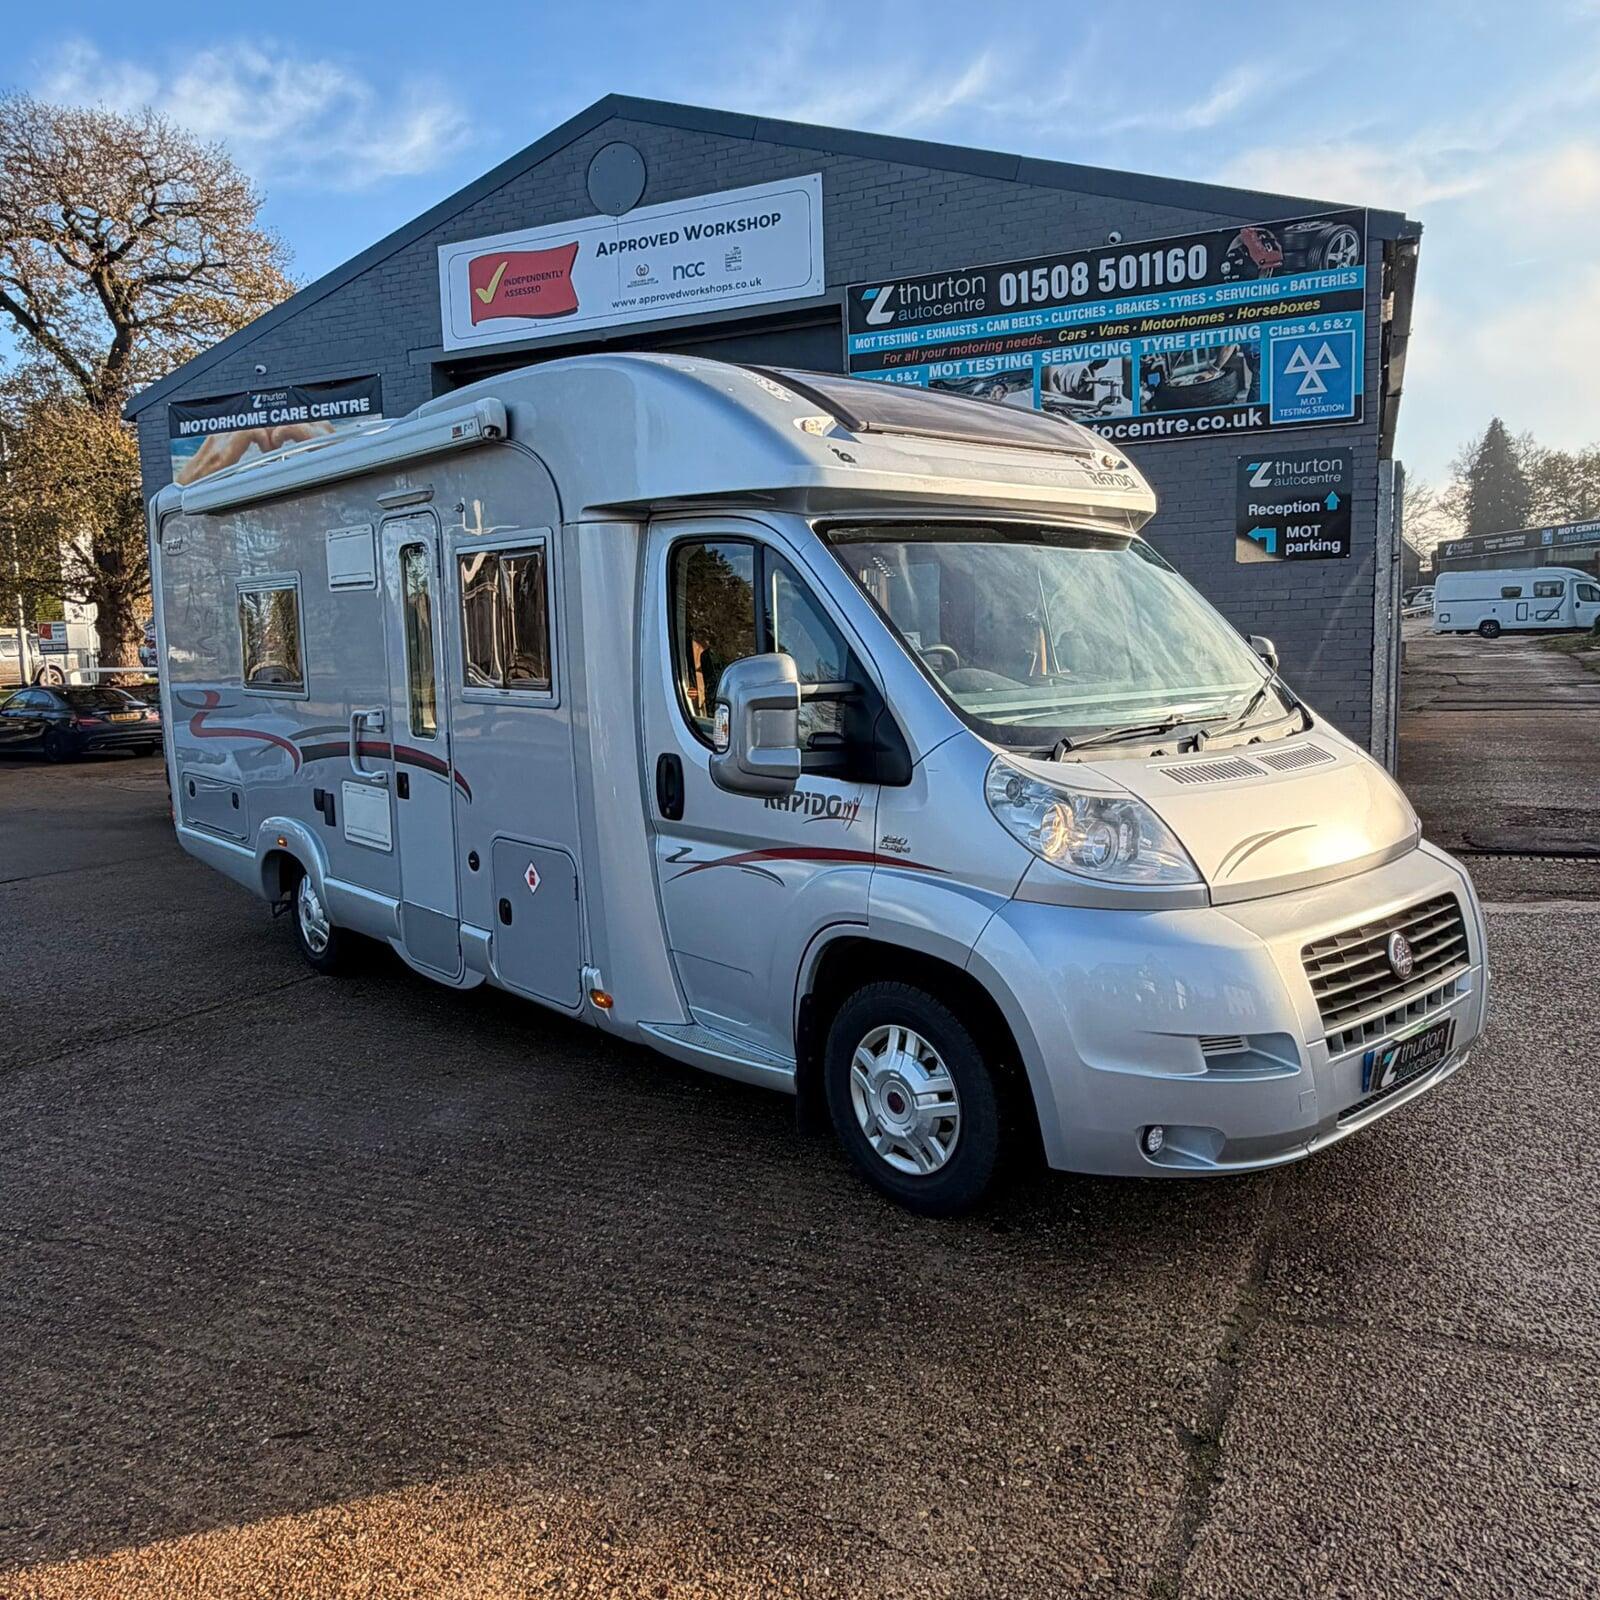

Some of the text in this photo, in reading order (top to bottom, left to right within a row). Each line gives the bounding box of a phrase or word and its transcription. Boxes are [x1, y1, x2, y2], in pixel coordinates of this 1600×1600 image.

[596, 212, 782, 258] APPROVED WORKSHOP
[504, 270, 564, 286] INDEPENDENTLY
[672, 261, 705, 280] ncc
[1000, 244, 1207, 306] 01508 501160
[504, 285, 541, 298] ASSESSED
[612, 278, 762, 308] www.approvedworkshops.co.uk
[898, 276, 986, 305] thurton
[855, 272, 1358, 350] MOT TESTING EXHAUSTS CAM BELTS CLUTCHES BRAKES TYRES SERVICING BATTERIES
[898, 298, 985, 321] autocentre
[882, 353, 902, 365] For
[904, 349, 919, 362] all
[920, 347, 946, 362] your
[949, 340, 1003, 355] motoring
[1058, 329, 1087, 341] Cars
[1099, 323, 1130, 337] Vans
[1141, 312, 1225, 332] Motorhomes
[1237, 299, 1321, 320] Horseboxes
[1141, 325, 1261, 352] TYRE FITTING
[1269, 325, 1305, 337] Class
[1308, 321, 1320, 332] 4,
[1041, 341, 1132, 364] SERVICING
[929, 353, 1033, 378] MOT TESTING
[180, 397, 370, 435] MOTORHOME CARE CENTRE
[1280, 403, 1344, 416] TESTING STATION
[1091, 407, 1263, 440] tocentre.co.uk
[1274, 458, 1343, 476] thurton
[1273, 473, 1342, 487] autocentre
[1248, 500, 1321, 517] Reception
[1286, 525, 1322, 538] MOT
[1557, 526, 1575, 536] MOT
[1285, 538, 1341, 556] parking
[1401, 1028, 1445, 1064] thurton
